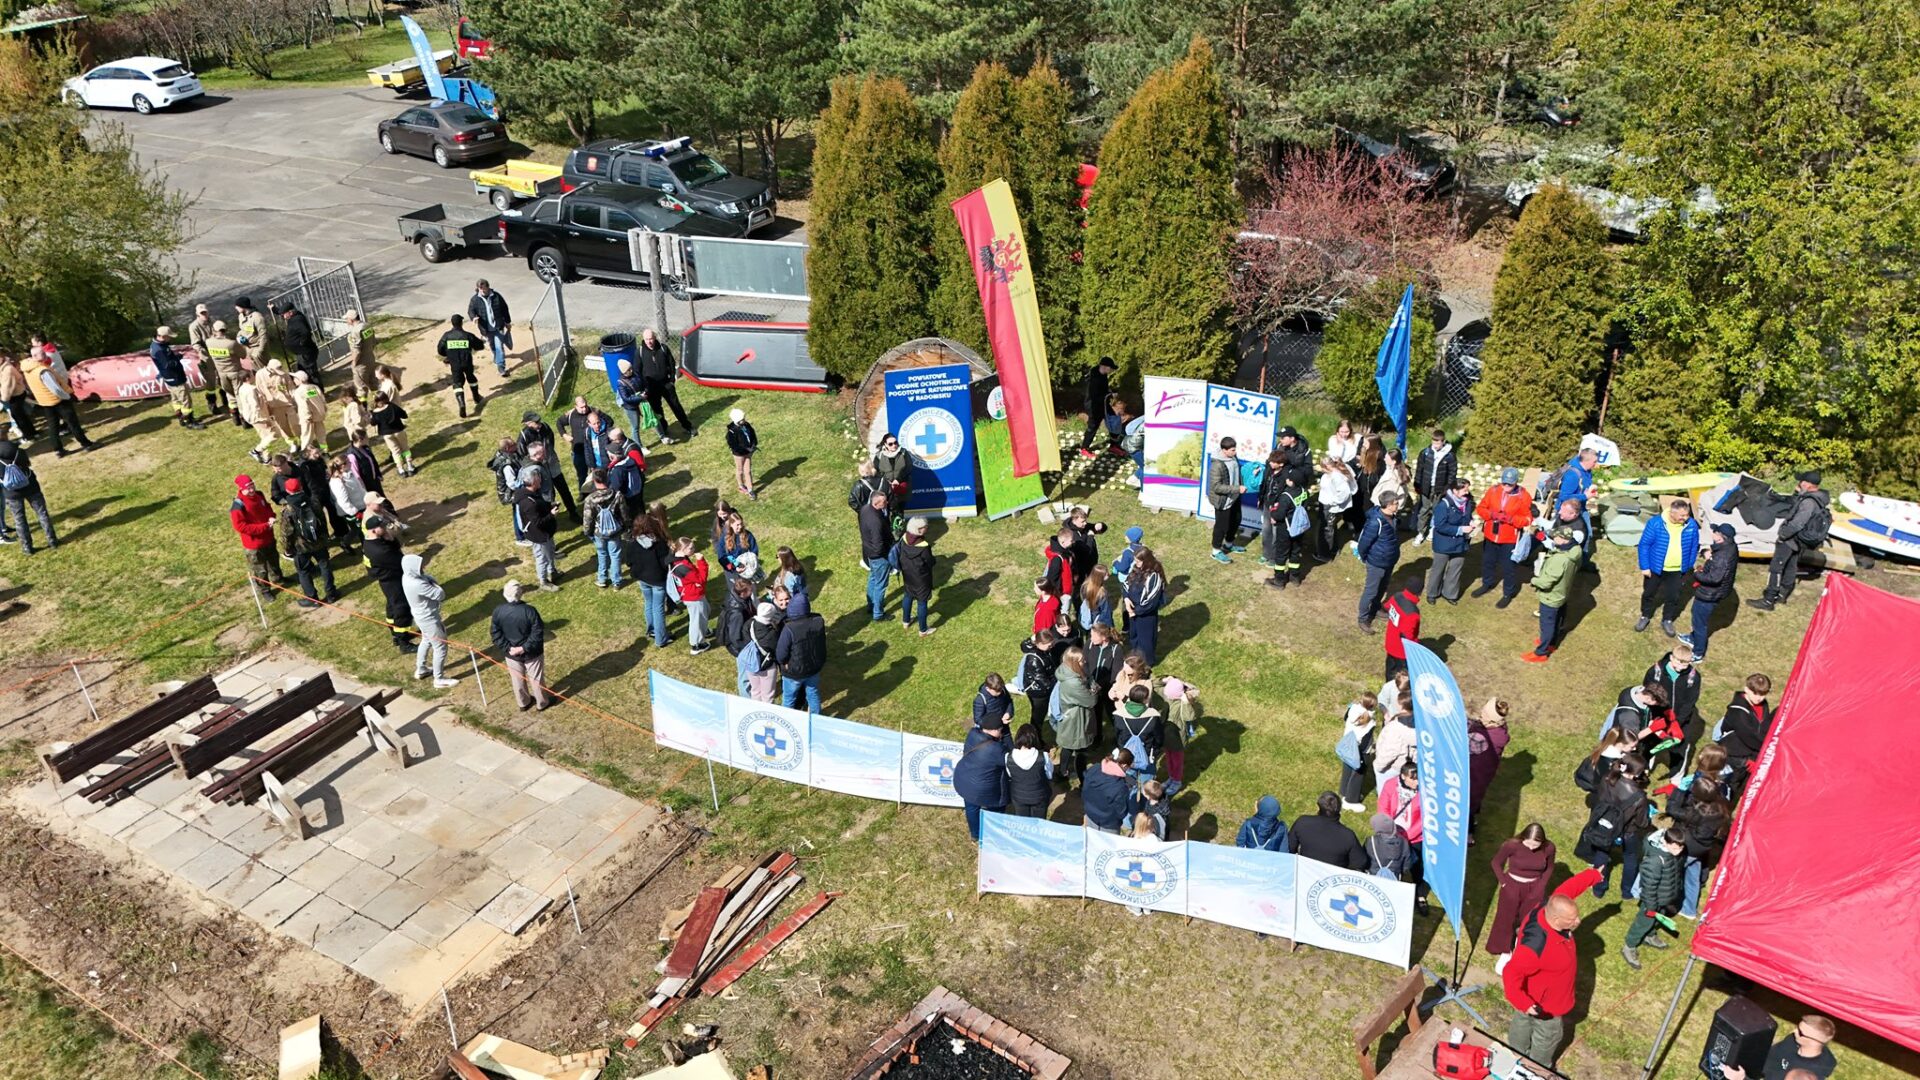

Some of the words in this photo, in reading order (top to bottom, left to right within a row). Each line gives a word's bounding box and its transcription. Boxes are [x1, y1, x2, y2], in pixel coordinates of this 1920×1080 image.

[908, 372, 947, 383] POWIATOWE
[895, 382, 920, 391] WODNE
[920, 378, 961, 388] OCHOTNICZE
[888, 388, 927, 398] POGOTOWIE
[928, 384, 968, 394] RATUNKOWE
[915, 392, 952, 402] RADOMSKU
